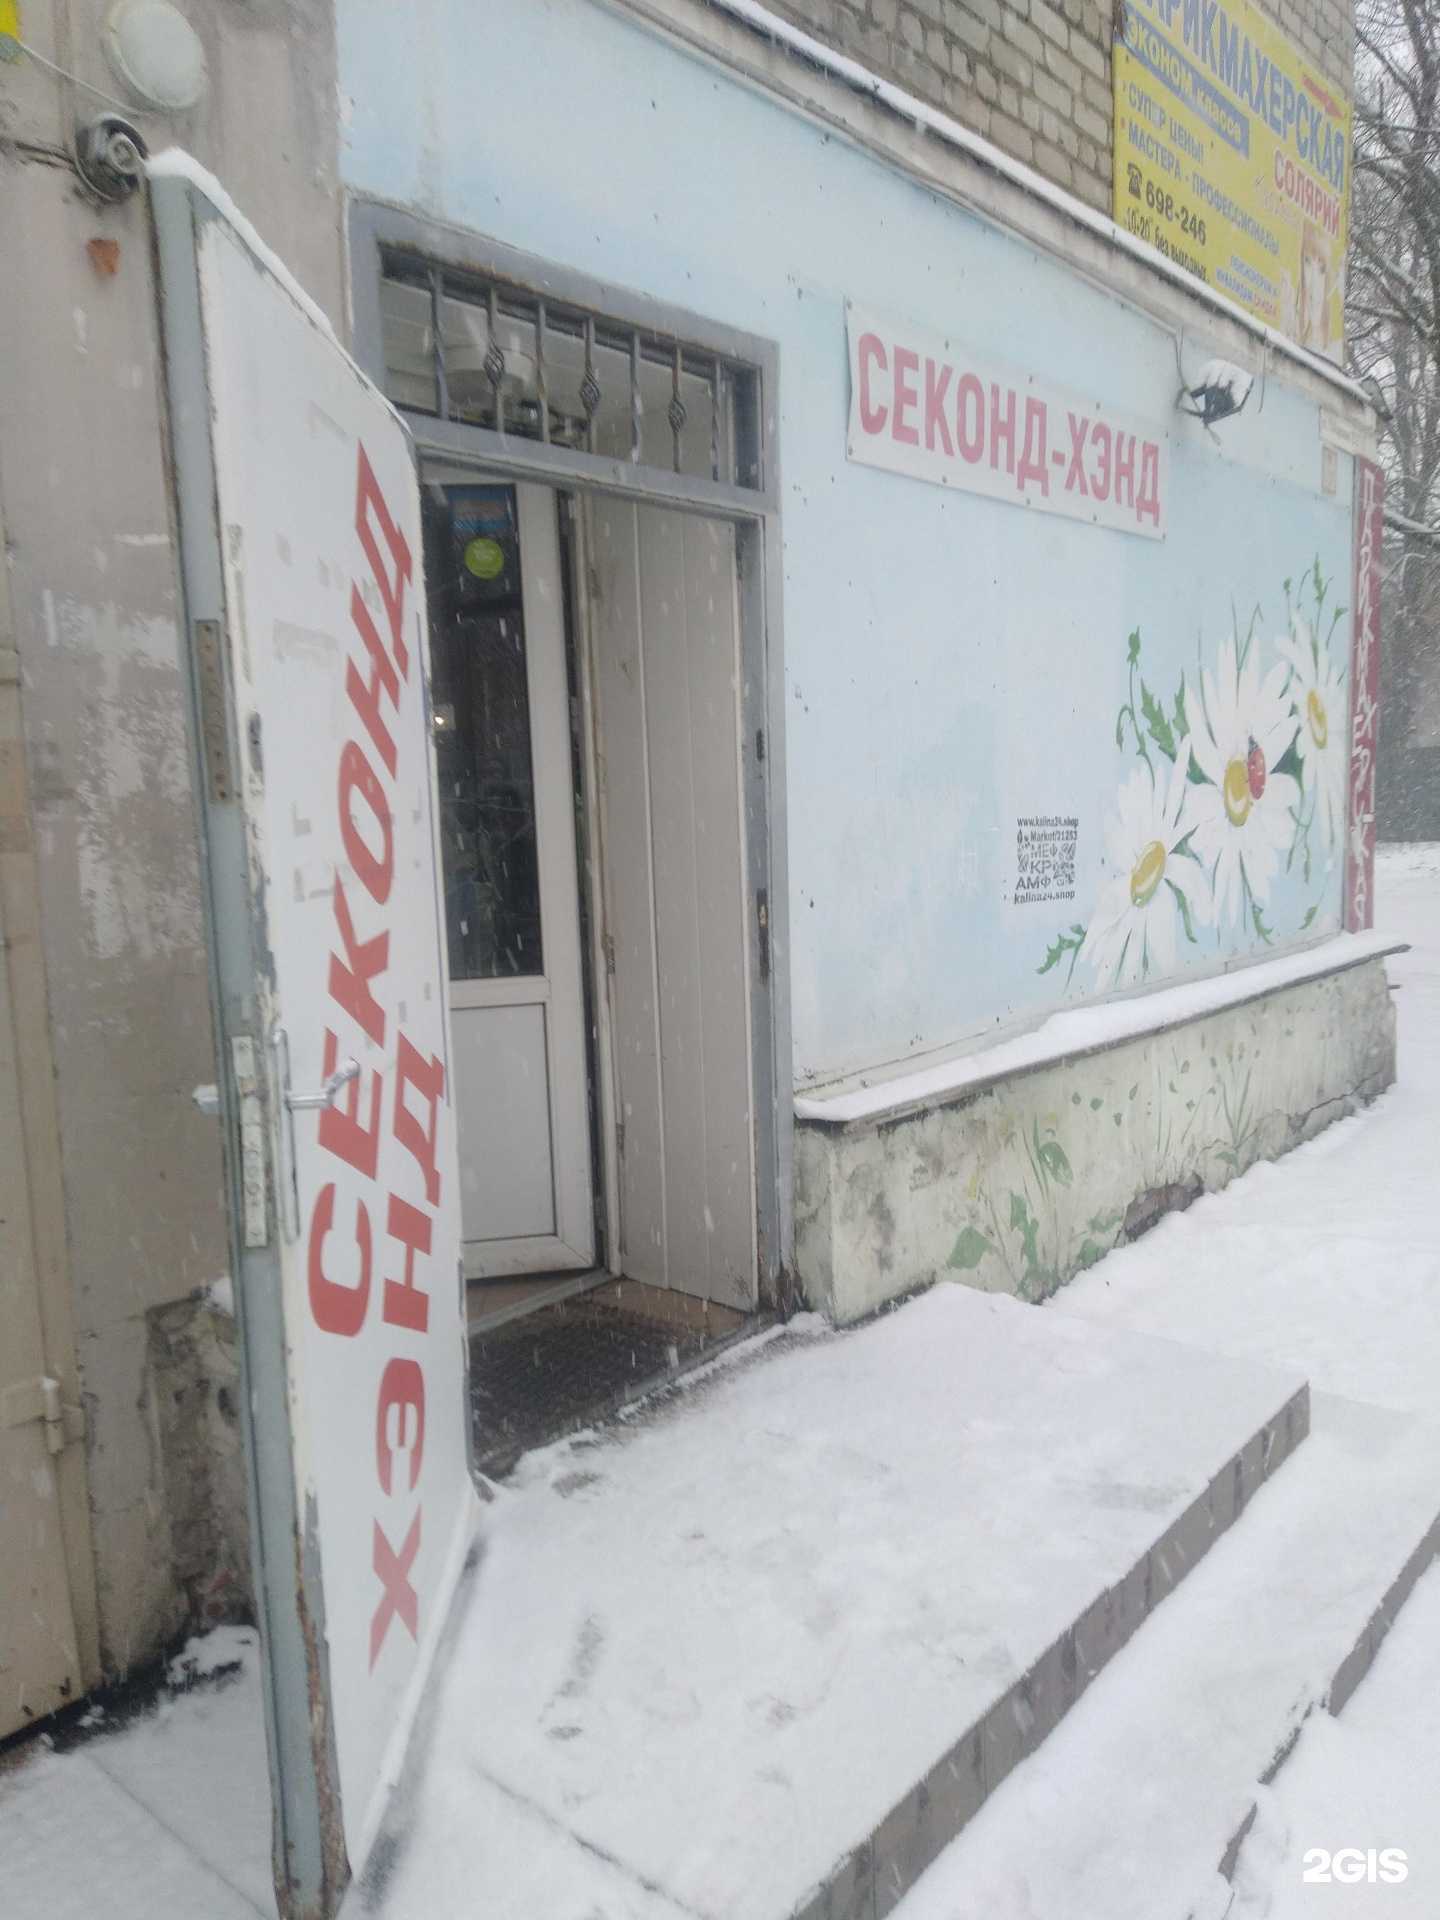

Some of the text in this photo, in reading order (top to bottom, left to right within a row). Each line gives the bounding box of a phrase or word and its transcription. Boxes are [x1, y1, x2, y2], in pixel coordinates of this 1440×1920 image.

[1128, 120, 1181, 182] МАСТЕРА
[1146, 180, 1206, 247] 698-246
[858, 333, 1160, 528] СЕКОНД-ХЭНД
[308, 438, 412, 1337] СЕКОНД
[367, 1030, 444, 1676] ХЭНД
